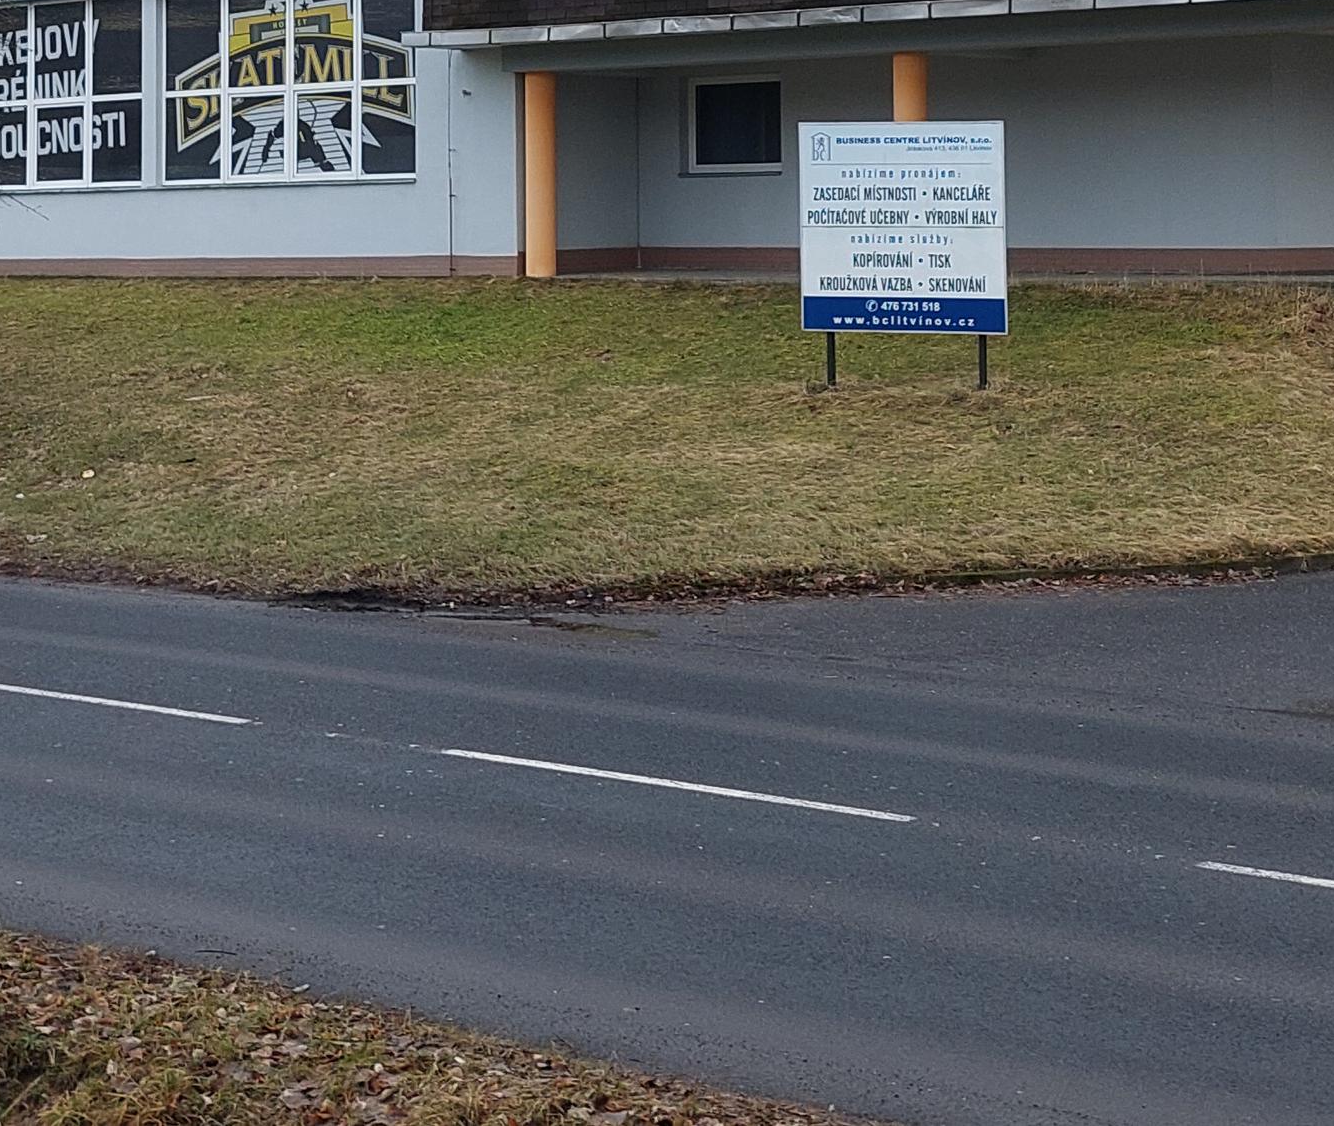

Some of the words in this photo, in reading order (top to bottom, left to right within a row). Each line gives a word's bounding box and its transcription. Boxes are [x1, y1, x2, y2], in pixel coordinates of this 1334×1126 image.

[186, 43, 404, 131] SATMIL
[836, 137, 881, 145] BUSINESS
[883, 137, 920, 145] CENTRE
[813, 185, 861, 201] ZASEDACÍ
[864, 185, 917, 201] MÍSTNOSTI
[932, 184, 991, 201] KANCELÁŘE
[807, 207, 867, 225] POČÍTAČOVÉ
[870, 208, 910, 225] UČEBNY
[925, 208, 969, 225] VÝROBNÍ
[972, 210, 998, 225] HALY
[852, 251, 913, 269] KOPÍROVÁNÍ
[928, 254, 952, 269] TISK
[820, 275, 878, 292] KROUŽKOVÁ
[880, 277, 913, 292] VAZBA
[928, 276, 986, 293] SKENOVÁNÍ
[880, 302, 900, 312] 476
[902, 302, 919, 312] 731
[922, 302, 941, 312] 518
